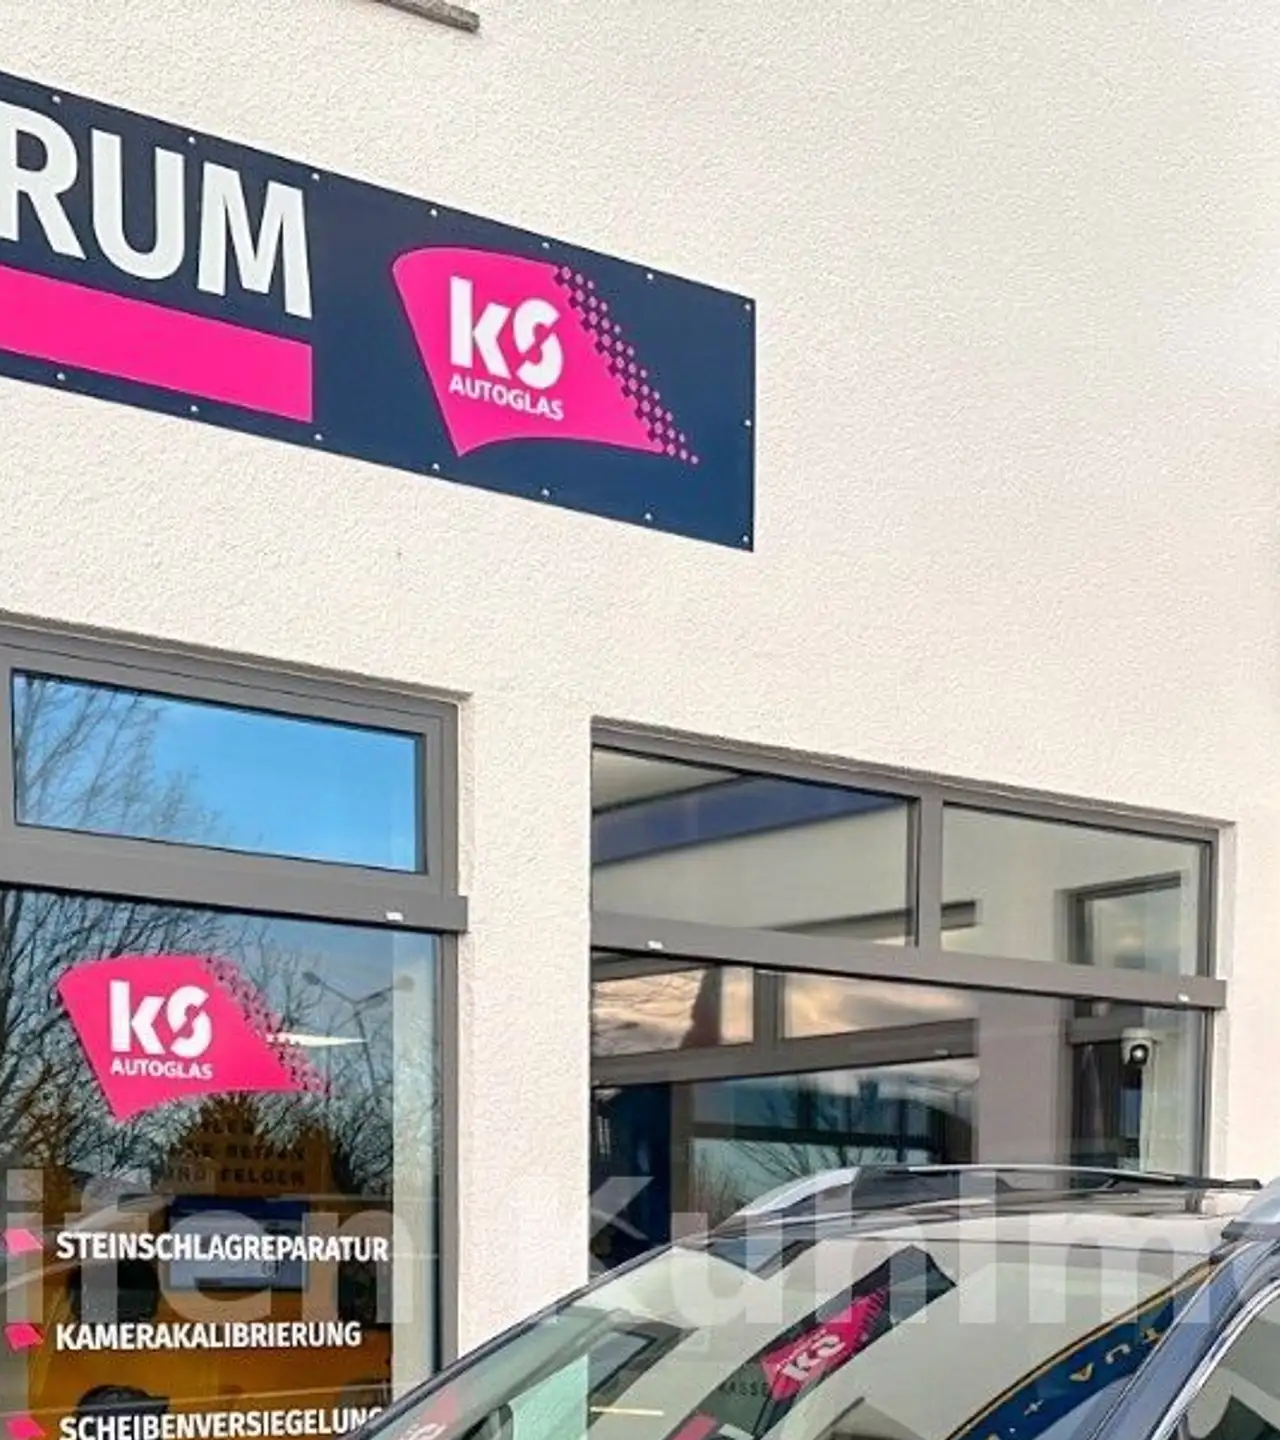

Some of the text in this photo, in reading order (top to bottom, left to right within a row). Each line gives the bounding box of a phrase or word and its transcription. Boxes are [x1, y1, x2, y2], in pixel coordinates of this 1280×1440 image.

[449, 373, 565, 421] AUTOGLAS
[110, 1058, 214, 1081] AUTOGLAS
[56, 1230, 390, 1263] STEINSCHLAGREPARATUR
[56, 1321, 362, 1352] KAMERAKALIBRIERUNG
